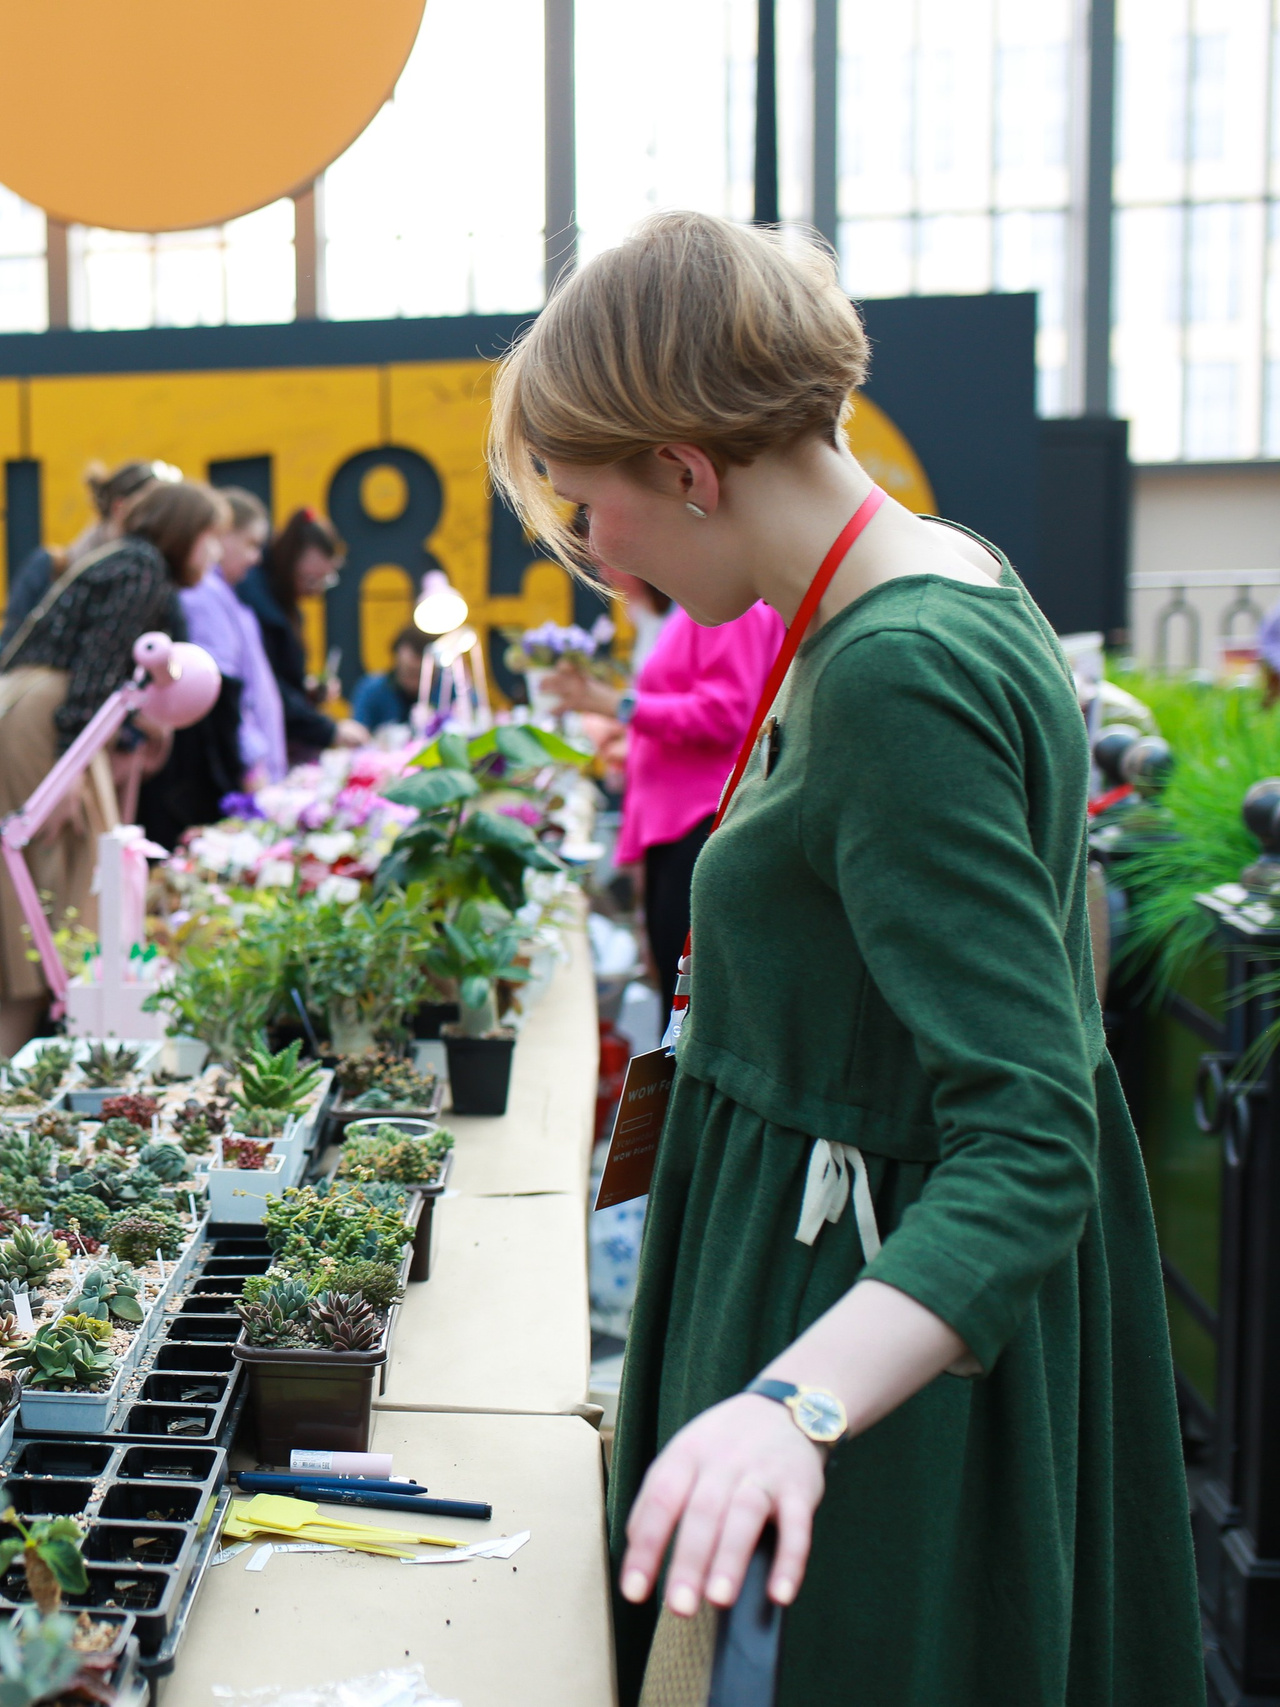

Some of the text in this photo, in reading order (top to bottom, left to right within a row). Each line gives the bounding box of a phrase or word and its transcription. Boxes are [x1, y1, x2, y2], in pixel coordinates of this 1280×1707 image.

[628, 1082, 657, 1102] WOW
[613, 1143, 655, 1163] WOW Plants
